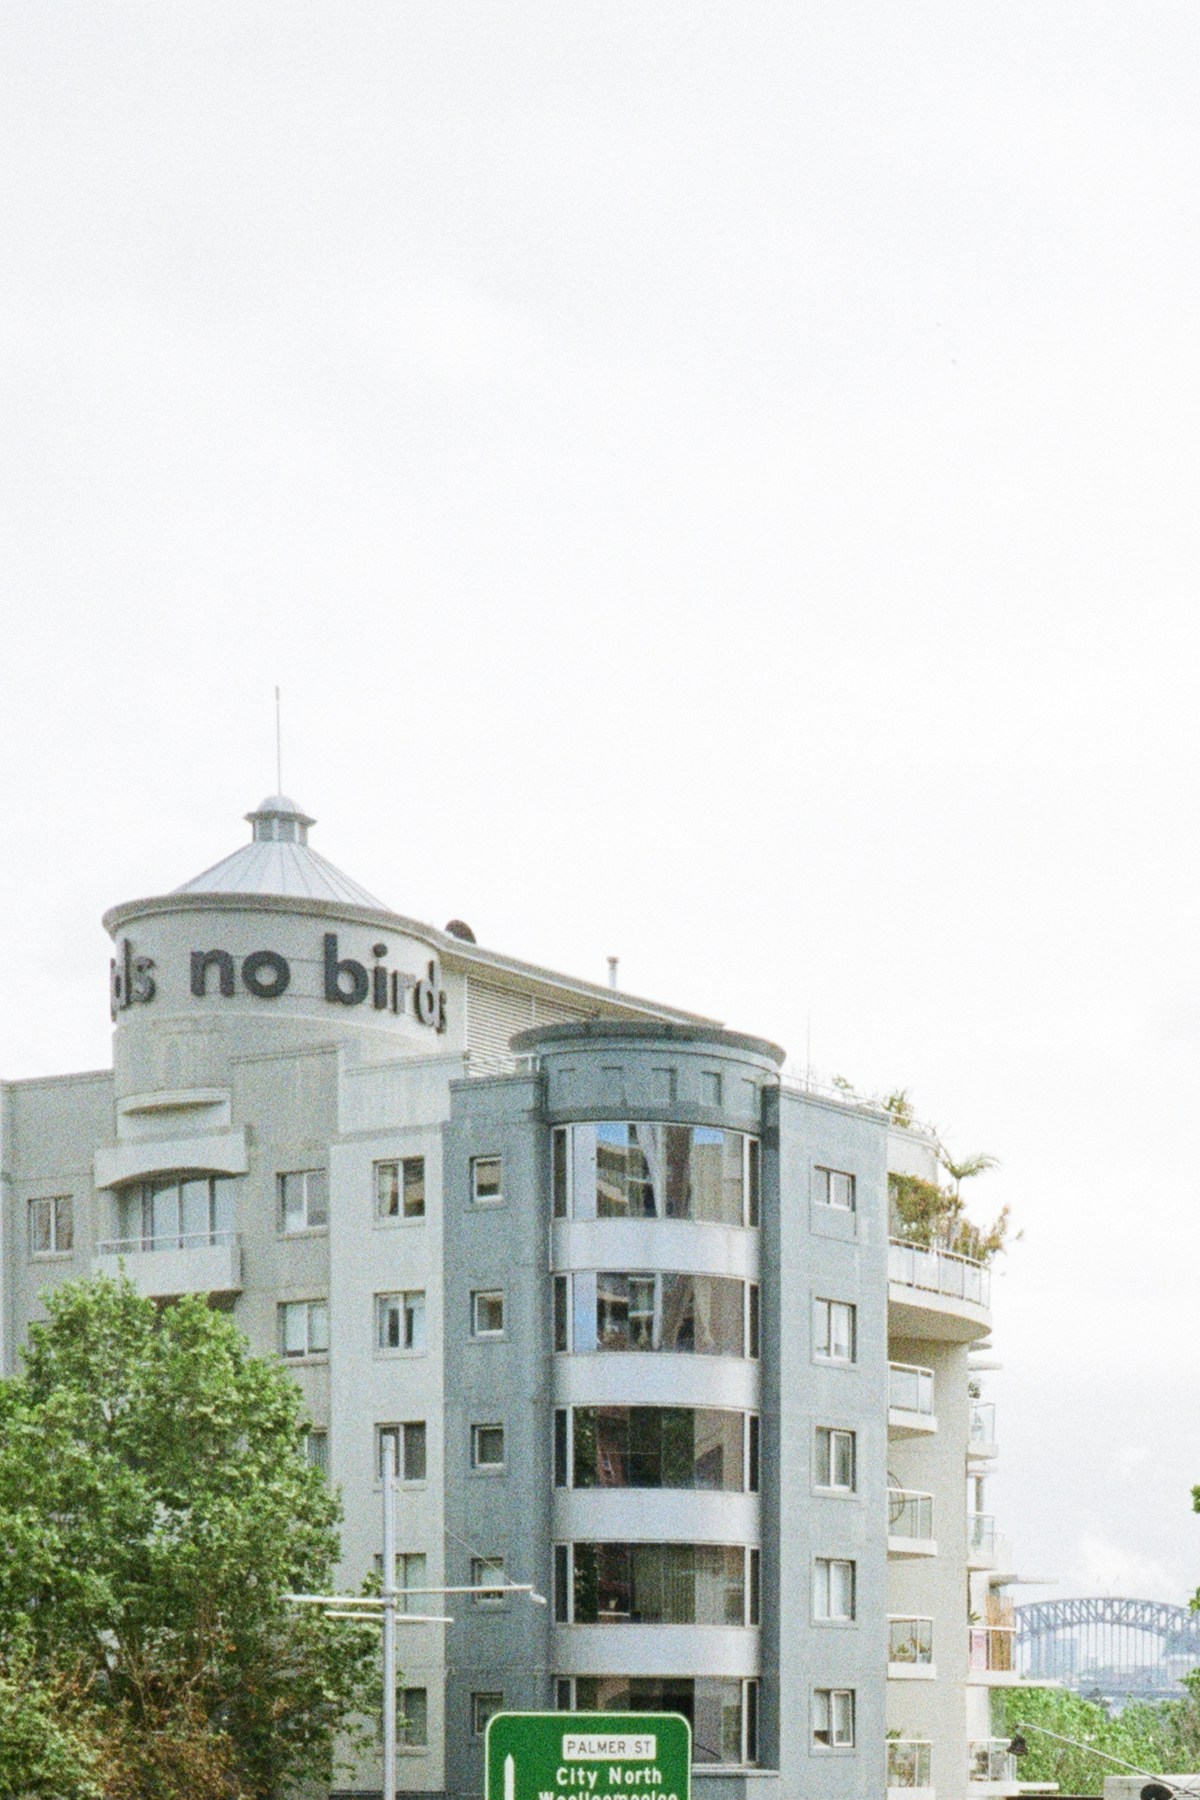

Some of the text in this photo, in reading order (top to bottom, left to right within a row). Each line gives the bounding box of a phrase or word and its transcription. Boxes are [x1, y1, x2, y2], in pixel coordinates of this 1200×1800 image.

[190, 949, 292, 999] no
[567, 1740, 651, 1755] PALMER ST
[556, 1766, 662, 1789] City North
